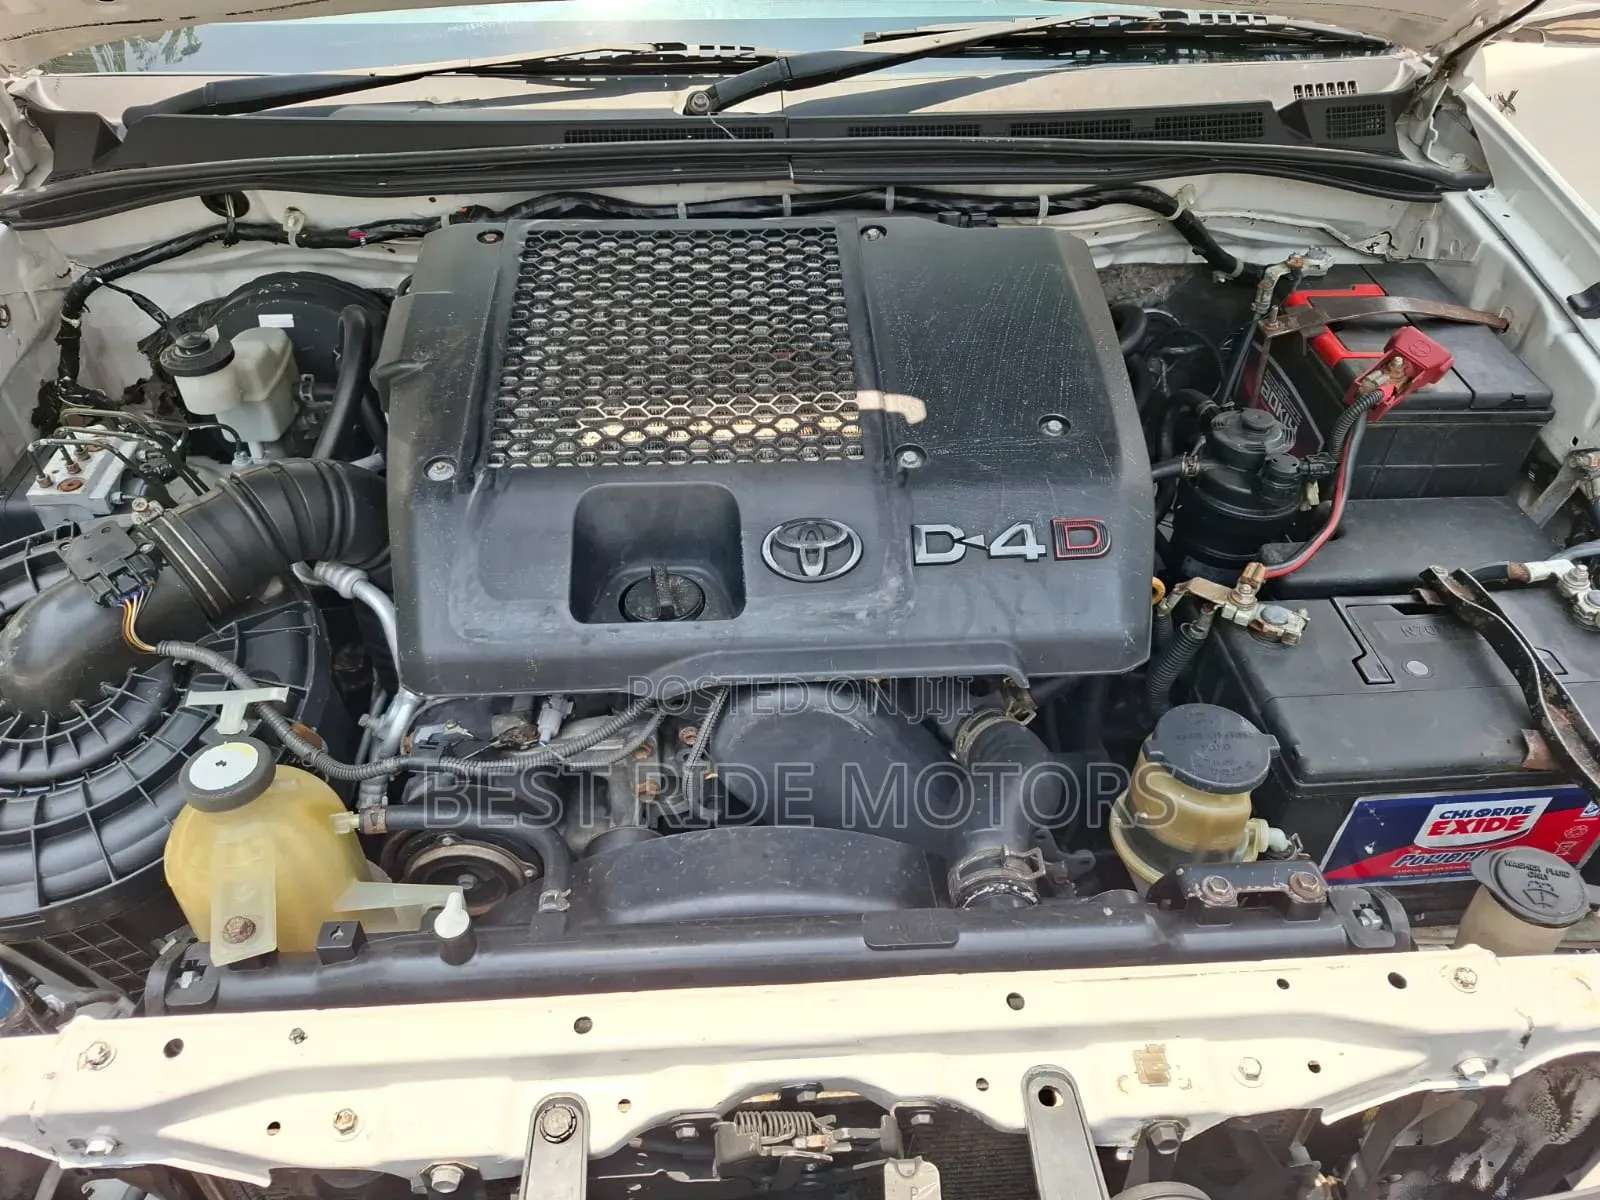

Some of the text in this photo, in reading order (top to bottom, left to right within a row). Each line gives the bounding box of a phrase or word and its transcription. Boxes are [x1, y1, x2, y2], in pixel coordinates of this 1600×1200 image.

[911, 518, 1112, 566] D-4D
[1439, 805, 1537, 819] CHLORIDE
[1427, 815, 1530, 836] EXIDE
